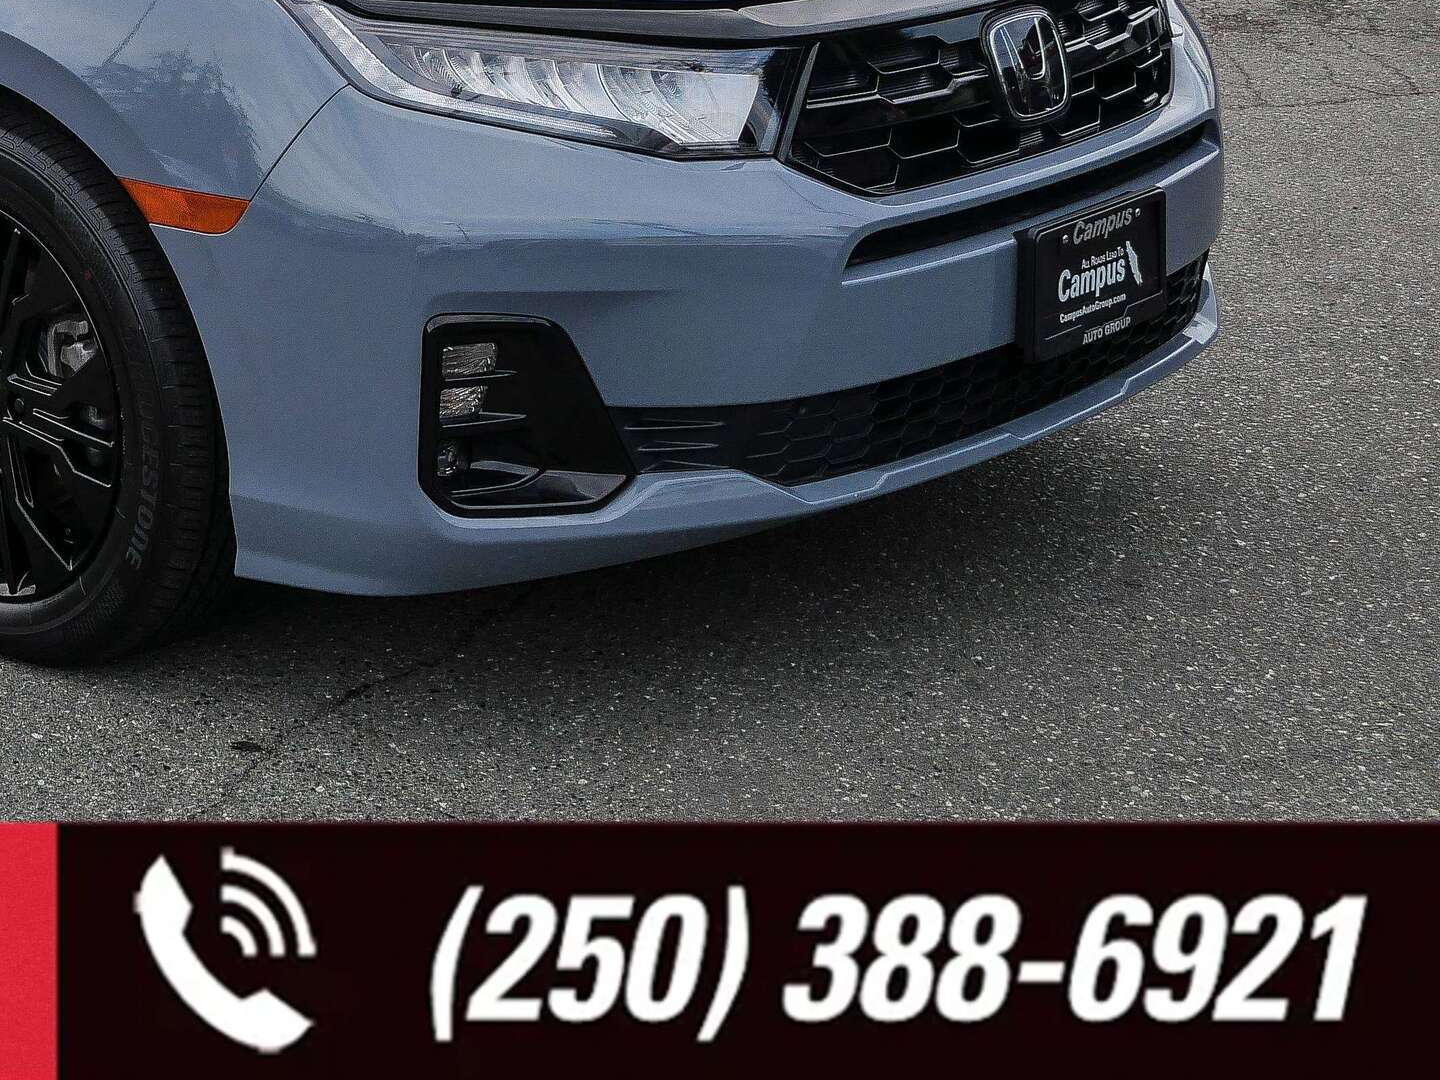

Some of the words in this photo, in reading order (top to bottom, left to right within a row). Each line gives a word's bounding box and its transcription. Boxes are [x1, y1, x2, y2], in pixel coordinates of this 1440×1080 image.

[1073, 208, 1132, 245] Campus
[1058, 258, 1126, 302] Campus
[1060, 293, 1126, 323] CampusAutoGroup.com
[1082, 327, 1103, 344] AUTO
[1104, 316, 1131, 336] GROUP
